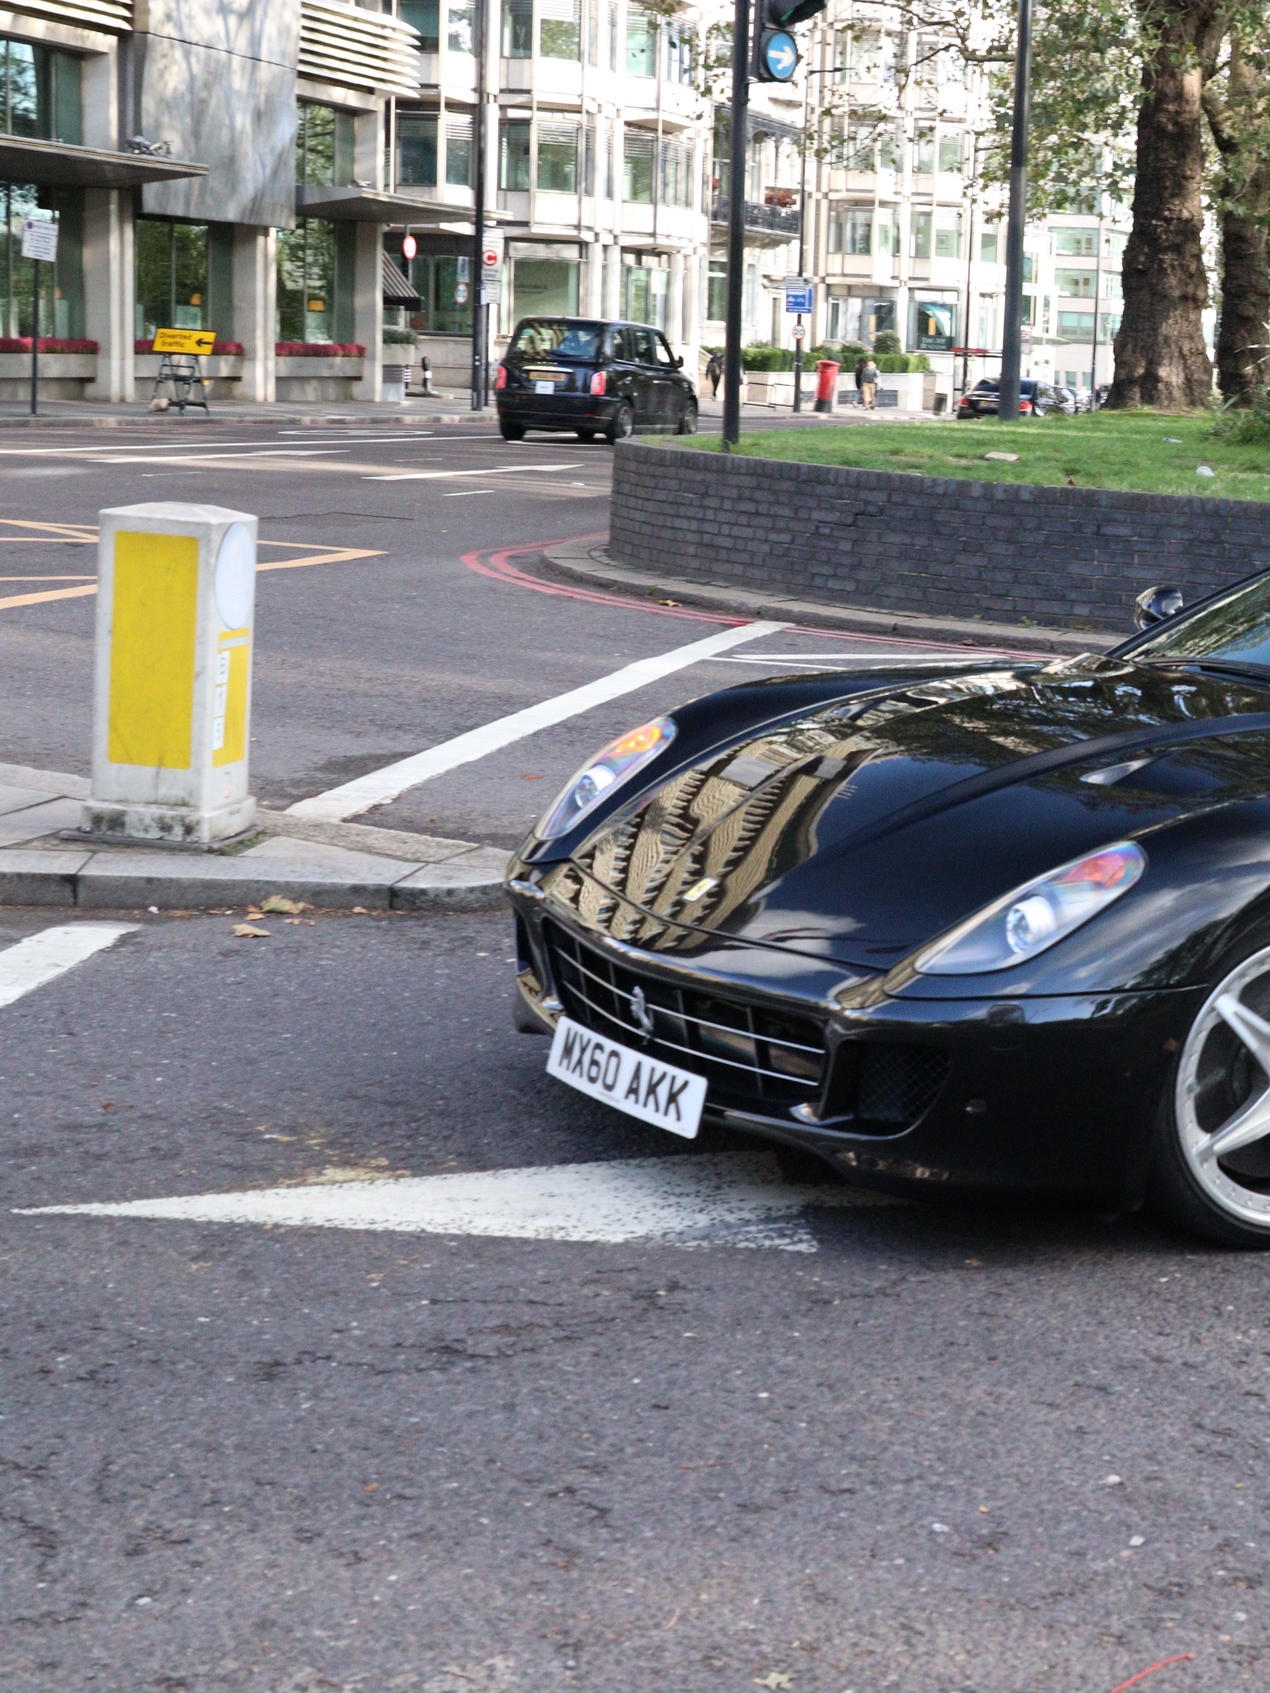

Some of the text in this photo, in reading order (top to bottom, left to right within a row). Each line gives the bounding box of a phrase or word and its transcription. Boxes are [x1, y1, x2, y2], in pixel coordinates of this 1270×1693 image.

[159, 332, 192, 340] Diverted
[558, 1026, 690, 1122] MX60 AKK
